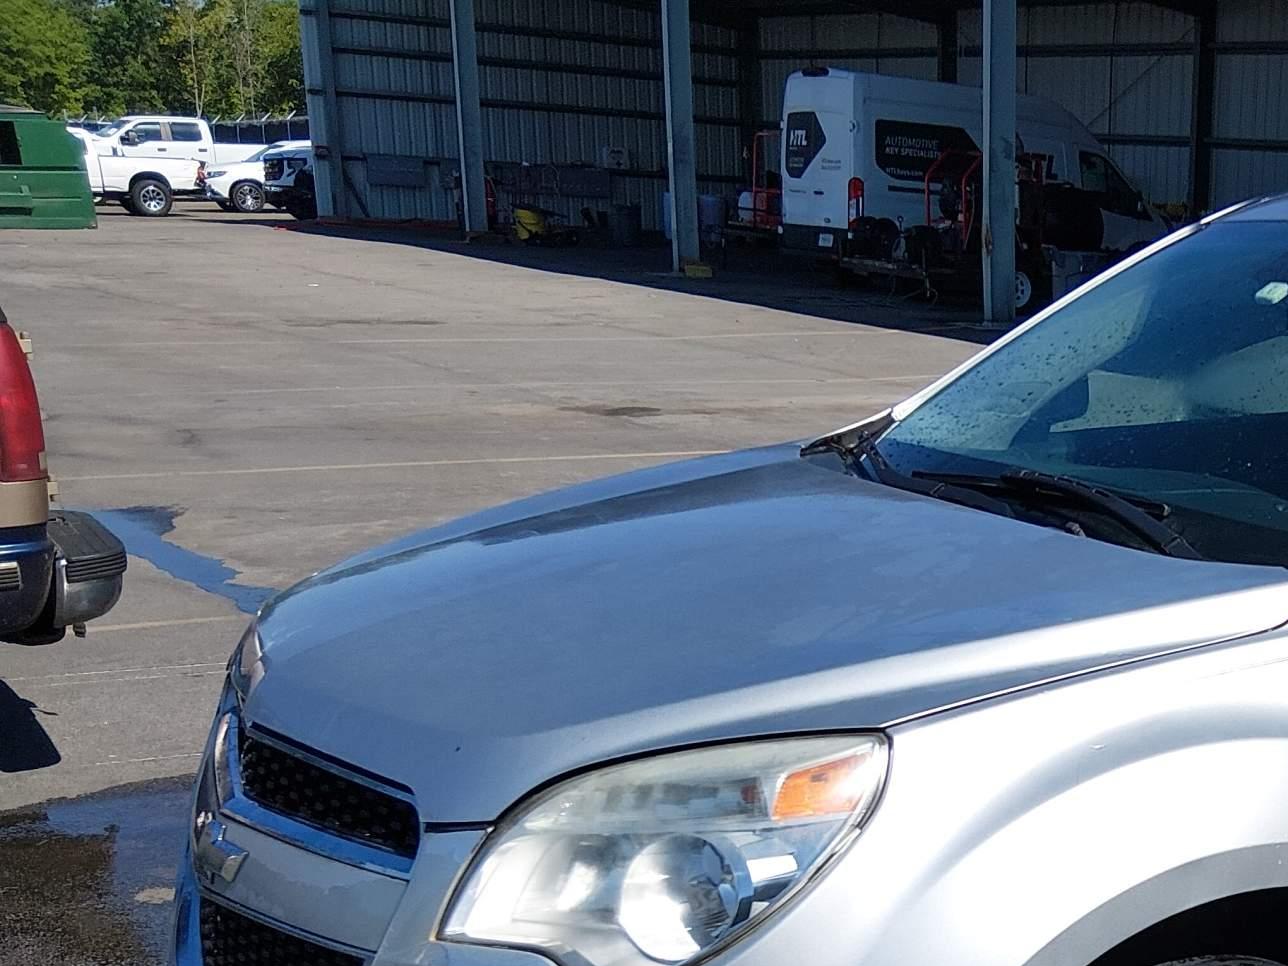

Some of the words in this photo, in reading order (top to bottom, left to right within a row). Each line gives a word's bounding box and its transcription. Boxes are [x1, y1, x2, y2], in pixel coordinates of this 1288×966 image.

[789, 129, 808, 146] HTL
[884, 136, 940, 149] AUTOMOTIVE
[884, 146, 899, 155] KEY
